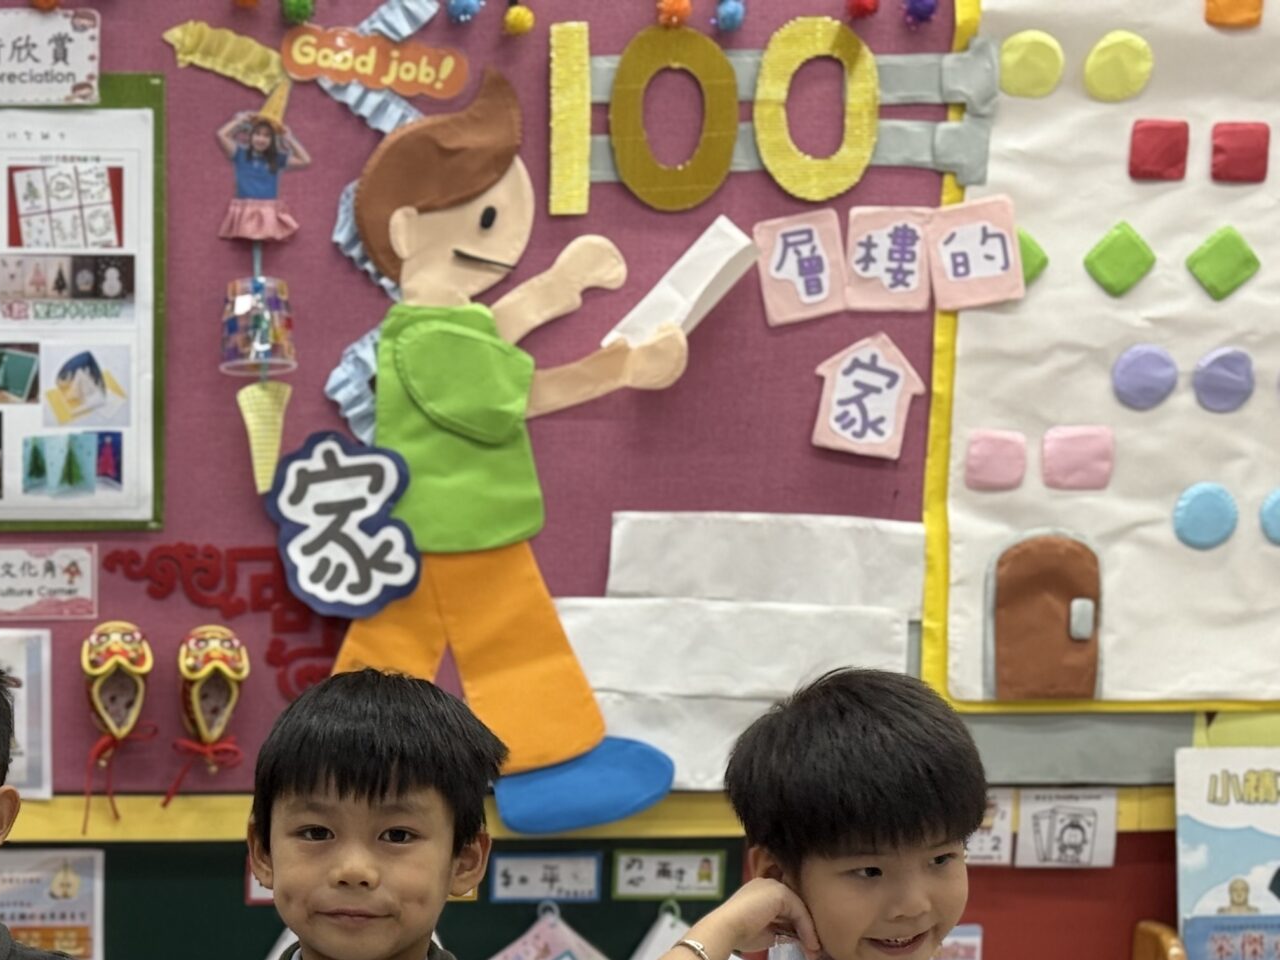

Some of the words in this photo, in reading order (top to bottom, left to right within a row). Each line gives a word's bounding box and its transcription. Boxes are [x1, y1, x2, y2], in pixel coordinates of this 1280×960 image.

[291, 34, 377, 75] Good
[380, 50, 455, 90] job!
[775, 224, 1010, 297] 層樓的
[834, 353, 900, 440] 家
[287, 448, 404, 596] 家
[37, 586, 78, 597] Corner
